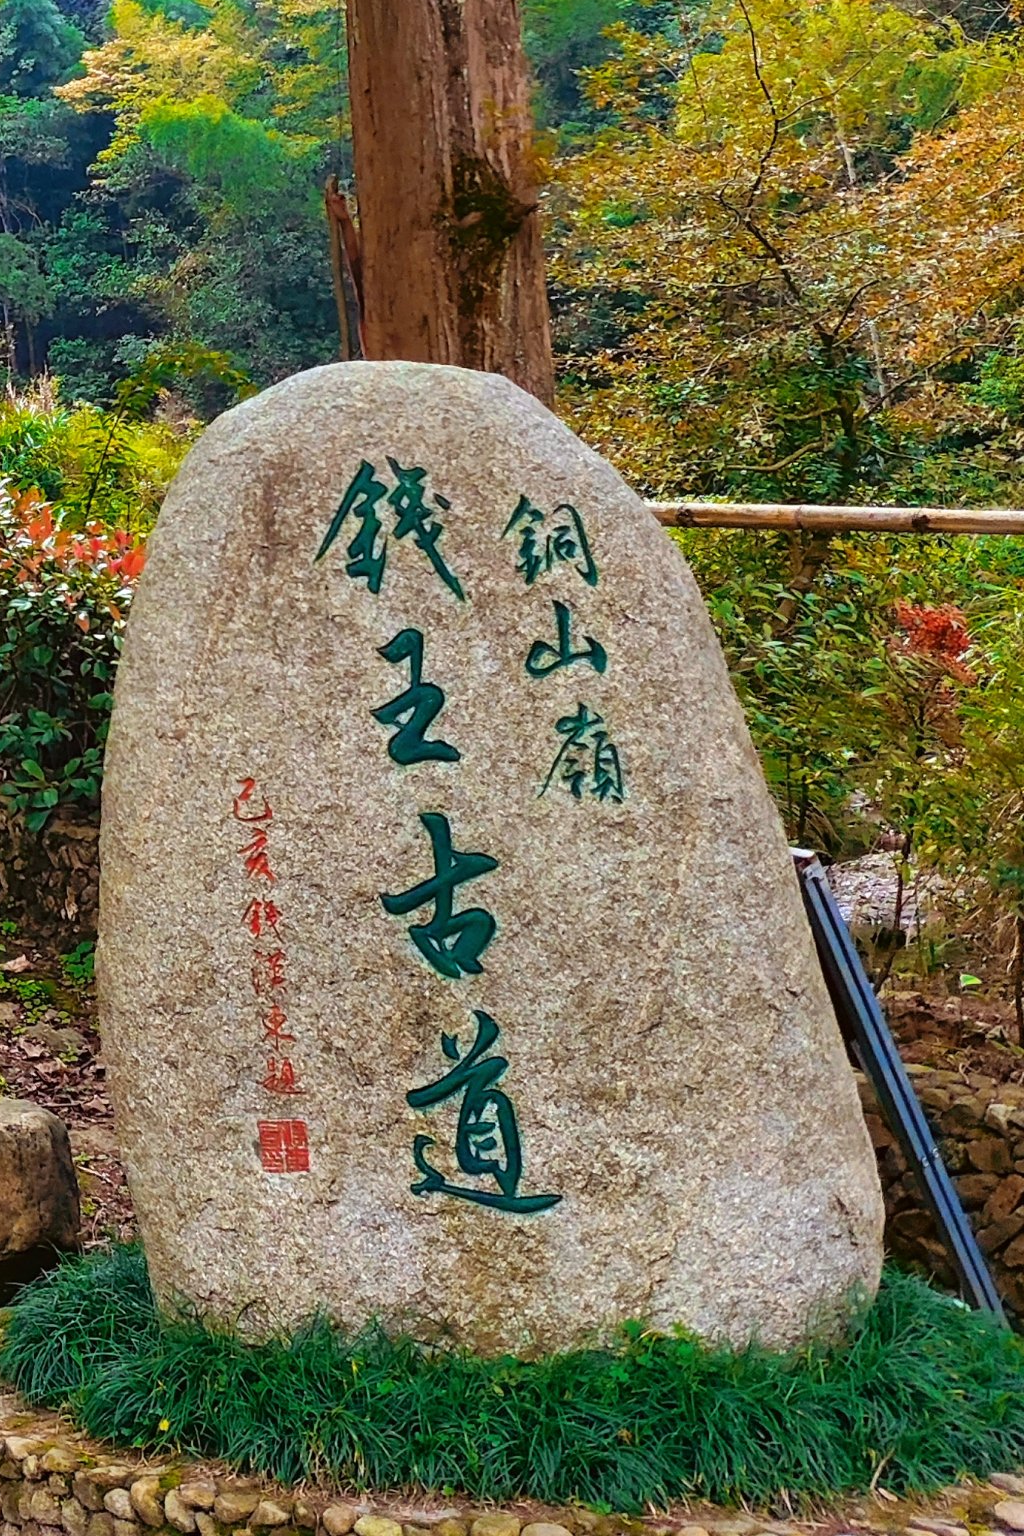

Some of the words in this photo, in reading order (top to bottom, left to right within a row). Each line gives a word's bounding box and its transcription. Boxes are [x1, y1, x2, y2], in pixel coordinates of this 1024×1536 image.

[314, 456, 564, 1214] 錢王古道
[500, 493, 625, 805] 銅山嶺
